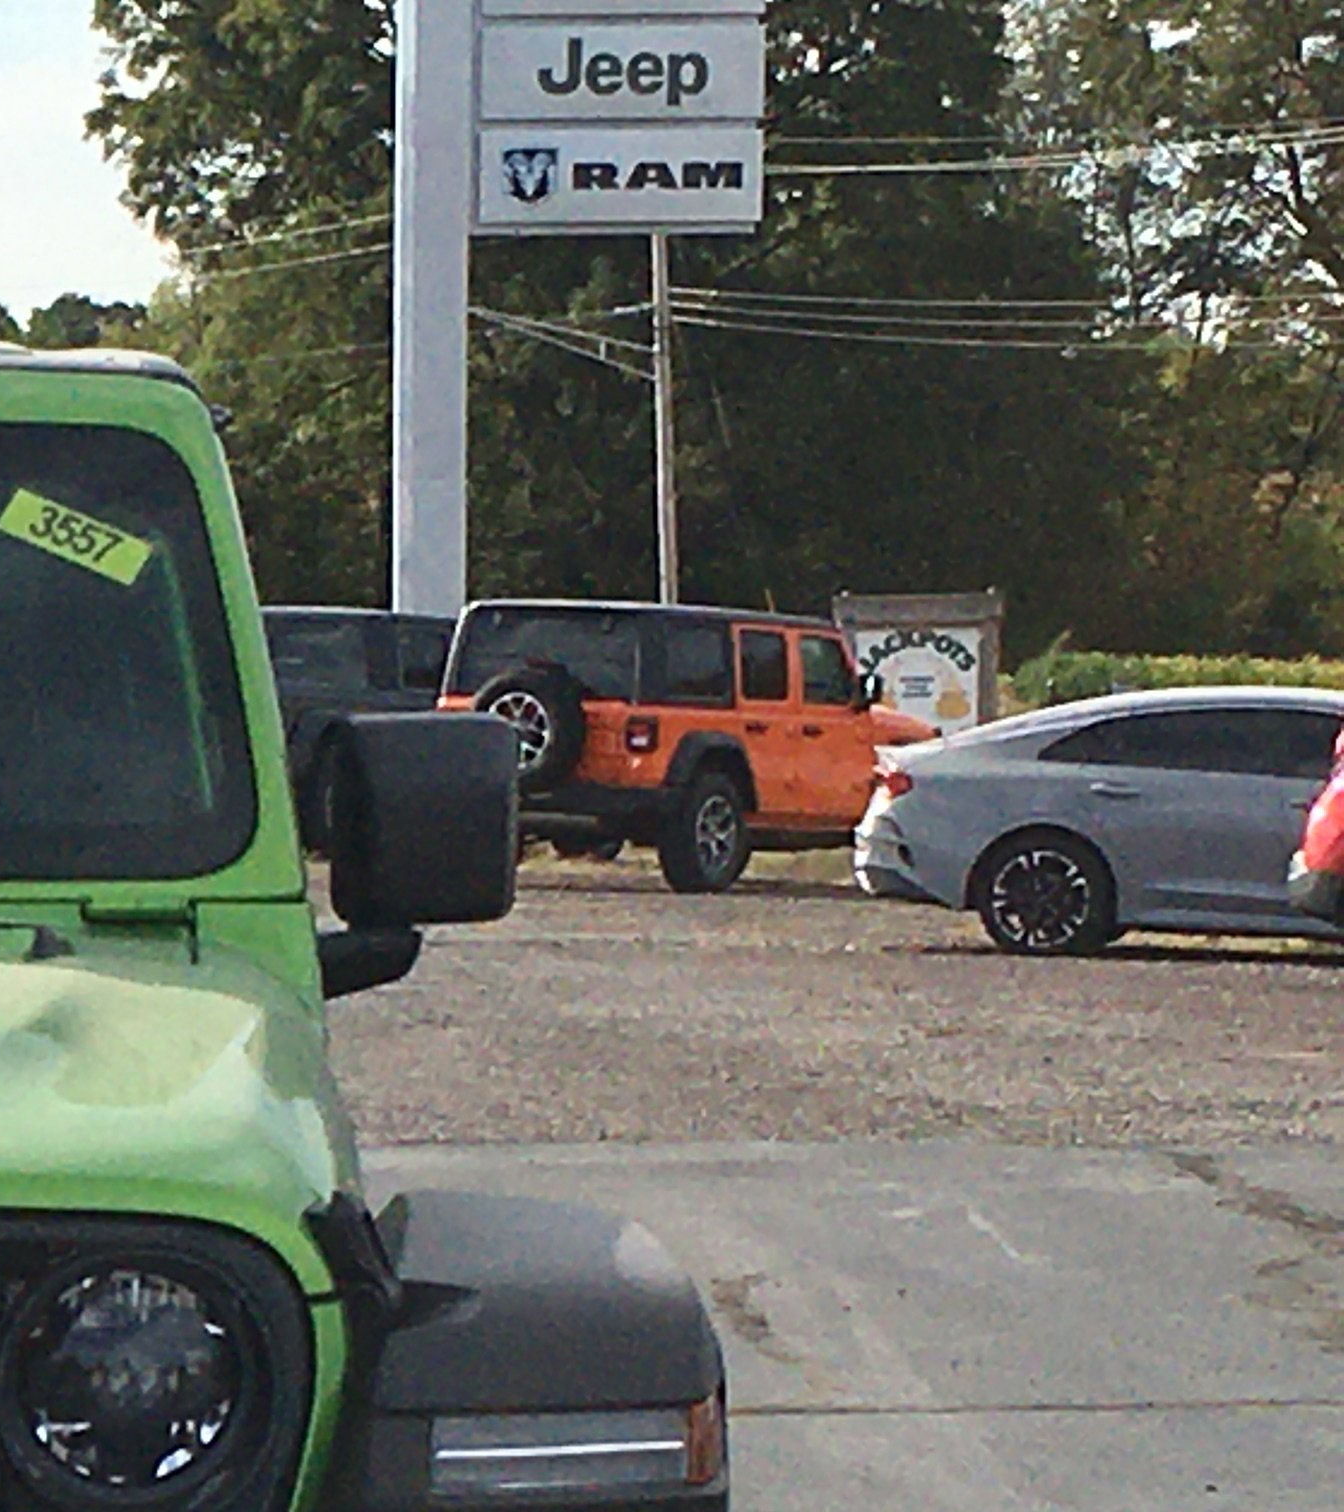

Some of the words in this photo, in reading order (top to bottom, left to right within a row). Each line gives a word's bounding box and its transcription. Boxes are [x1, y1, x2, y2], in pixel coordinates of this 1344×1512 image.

[537, 37, 709, 106] Jeep
[572, 162, 743, 190] RAM
[29, 506, 124, 562] 3557
